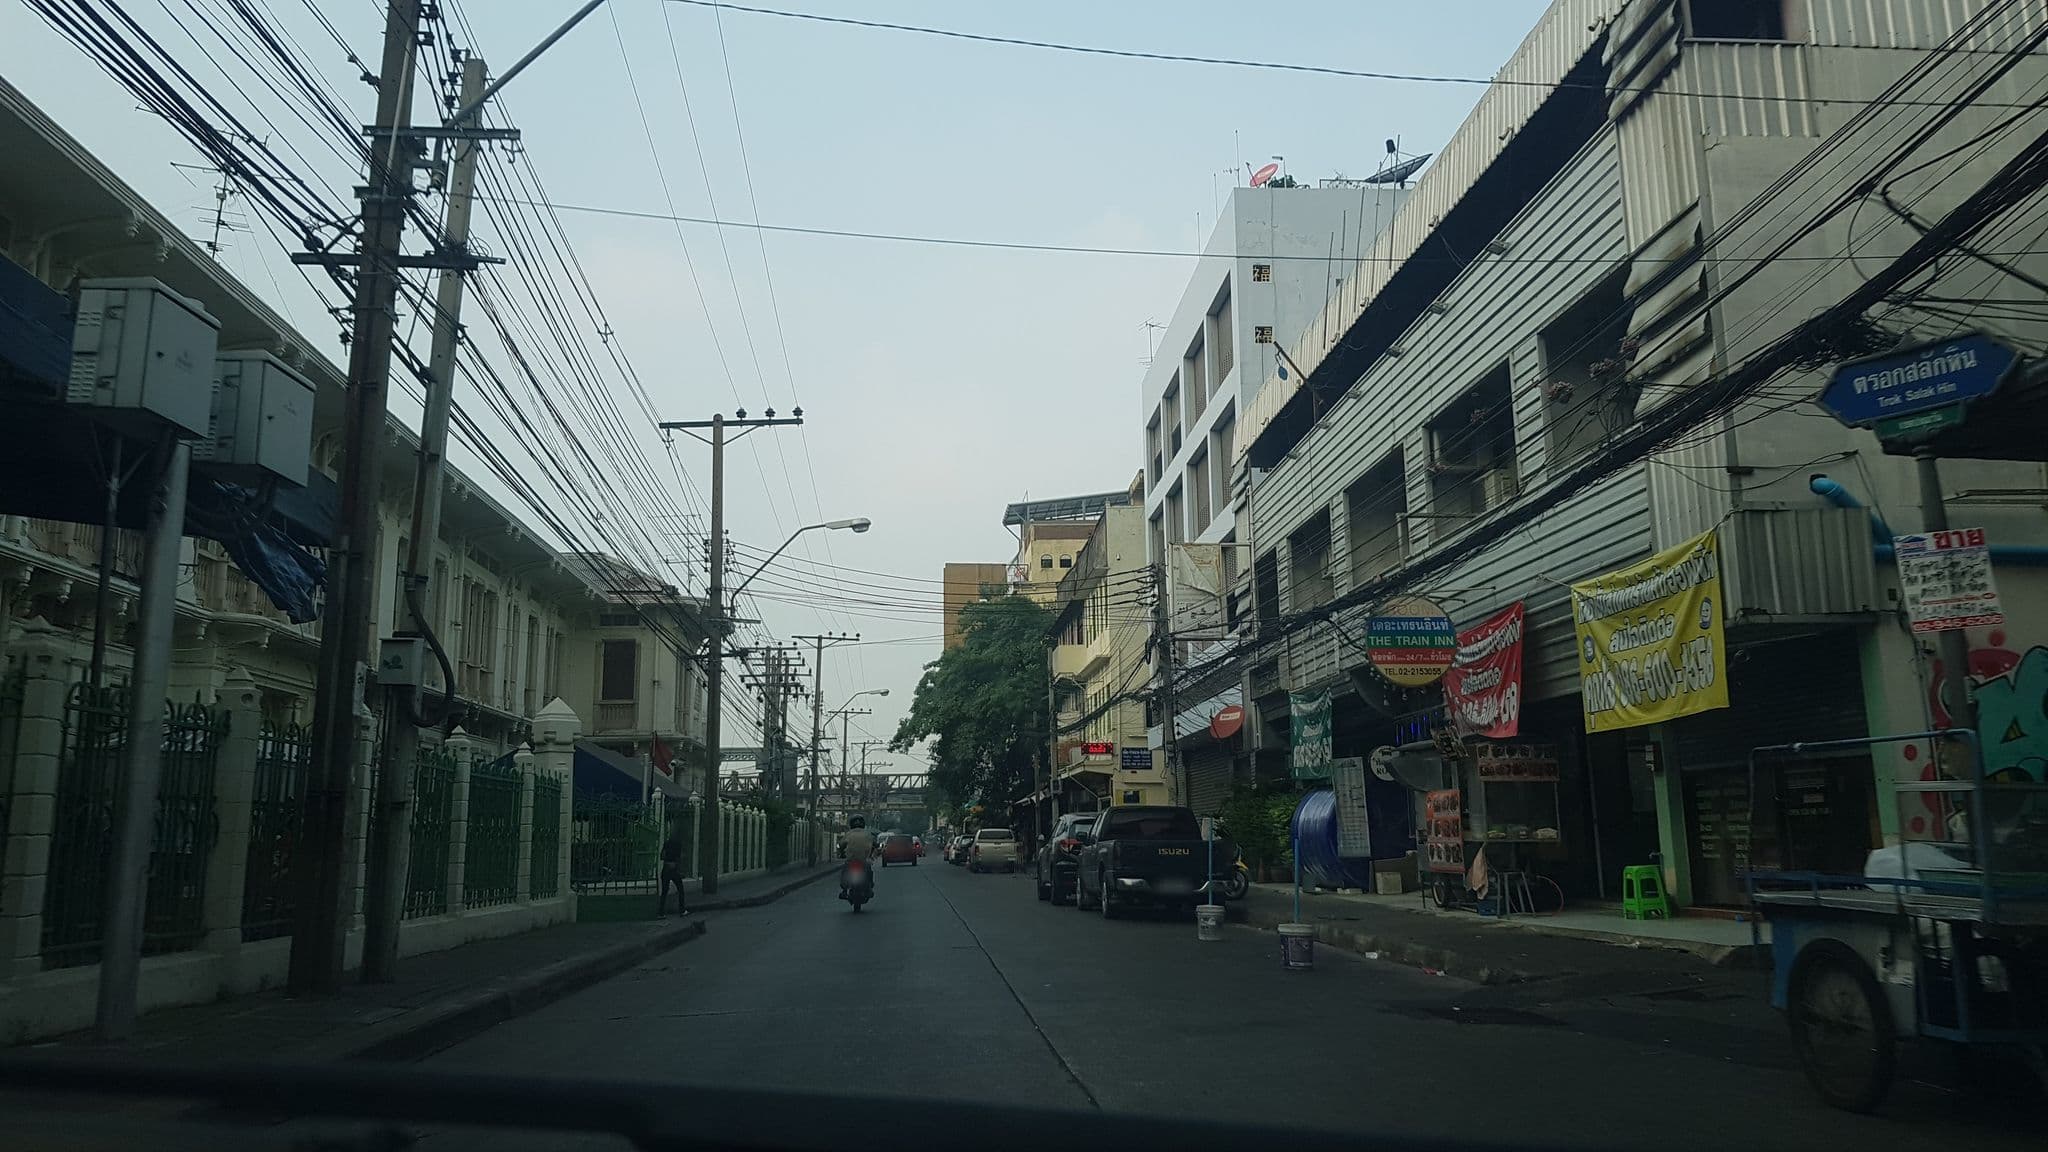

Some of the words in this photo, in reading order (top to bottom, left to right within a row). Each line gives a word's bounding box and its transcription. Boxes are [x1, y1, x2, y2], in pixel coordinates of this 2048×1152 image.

[1933, 529, 1985, 549] ขาย
[1609, 608, 1675, 653] สนใจติดต่อ
[1368, 635, 1392, 646] THE
[1395, 635, 1430, 646] TRAIN
[1434, 635, 1454, 646] INN
[1158, 847, 1190, 856] ISUZU
